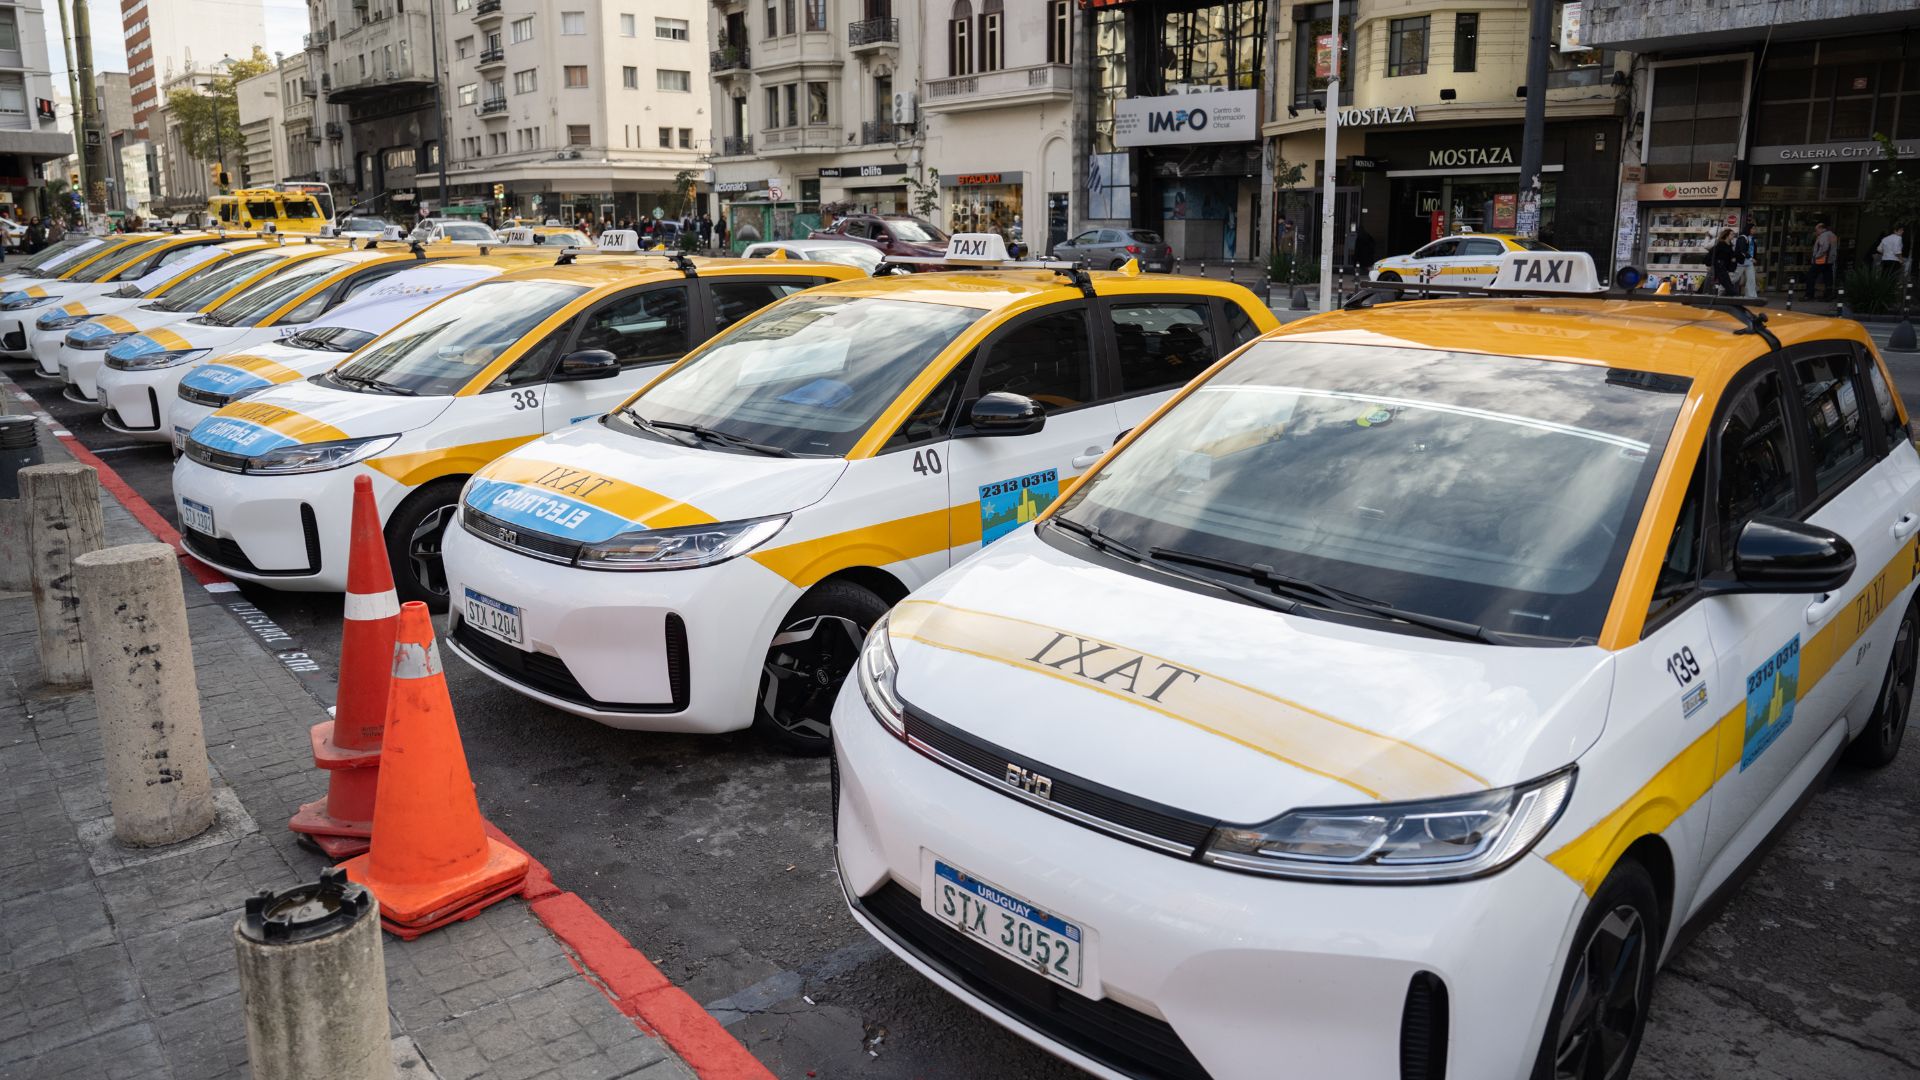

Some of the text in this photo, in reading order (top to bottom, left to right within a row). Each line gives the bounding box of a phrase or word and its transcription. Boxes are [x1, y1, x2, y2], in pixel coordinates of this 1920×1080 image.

[1148, 108, 1208, 133] IMPO
[1337, 105, 1415, 127] MOSTAZA
[1429, 147, 1513, 167] MOSTAZA
[1876, 145, 1915, 155] HLL
[860, 165, 882, 177] Lolita
[958, 174, 1000, 184] STADIUM
[1678, 184, 1718, 195] tomate
[511, 231, 525, 241] TAXI
[603, 233, 624, 247] TAXI
[953, 240, 987, 256] TAXI
[1513, 258, 1574, 284] TAXI
[511, 389, 539, 411] 38
[912, 448, 942, 476] 40
[981, 470, 1056, 499] 2313 0313
[498, 527, 518, 545] BYD
[1855, 573, 1886, 634] TAXI
[469, 600, 517, 638] STX 1204
[278, 652, 321, 672] BUS
[1666, 645, 1701, 688] 139
[1748, 640, 1799, 695] 2313 0313
[1005, 763, 1053, 800] BYD
[977, 884, 1032, 918] URUGUAY
[943, 884, 1070, 976] STX 3052
